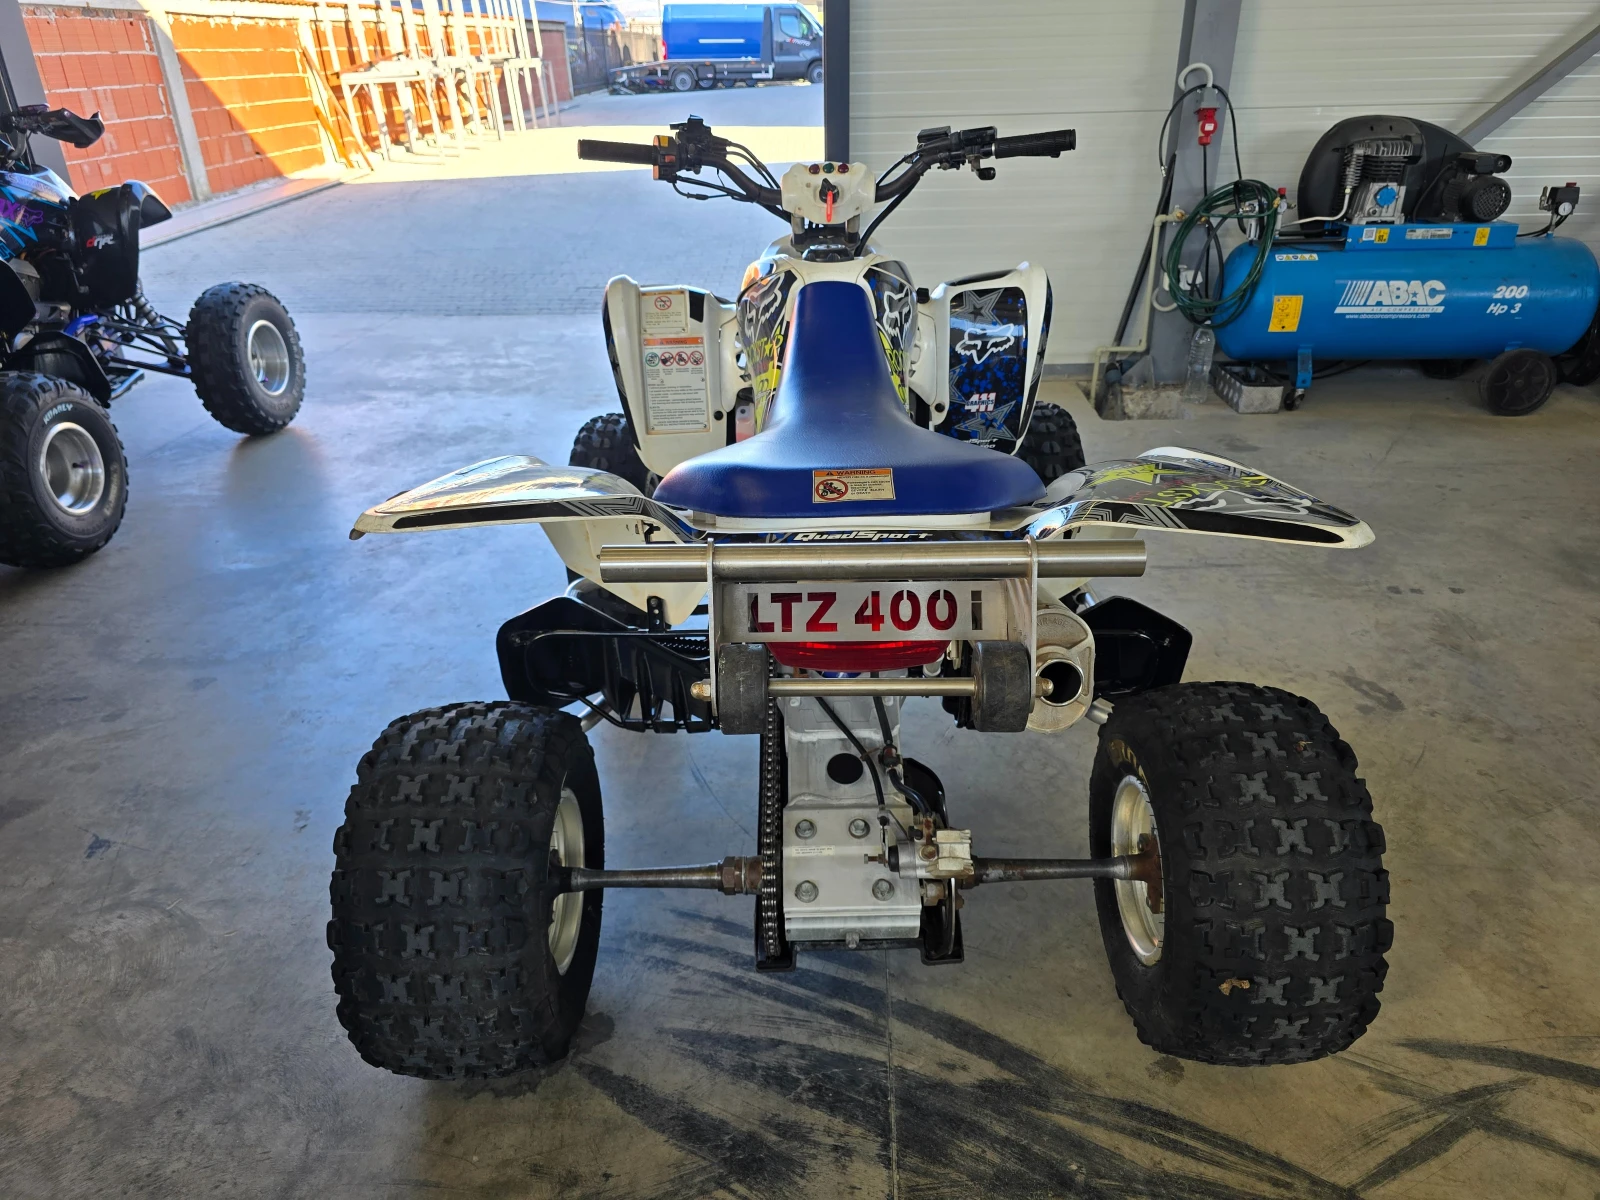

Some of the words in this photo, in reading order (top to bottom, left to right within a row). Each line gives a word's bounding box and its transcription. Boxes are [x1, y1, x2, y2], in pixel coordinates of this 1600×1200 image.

[1366, 279, 1446, 306] ABAC
[1492, 285, 1529, 299] 200
[1486, 302, 1509, 316] Hp
[1510, 302, 1523, 314] 3
[964, 392, 997, 412] 411
[792, 531, 933, 542] QuadSport
[747, 591, 838, 633] LTZ
[854, 589, 958, 632] 400
